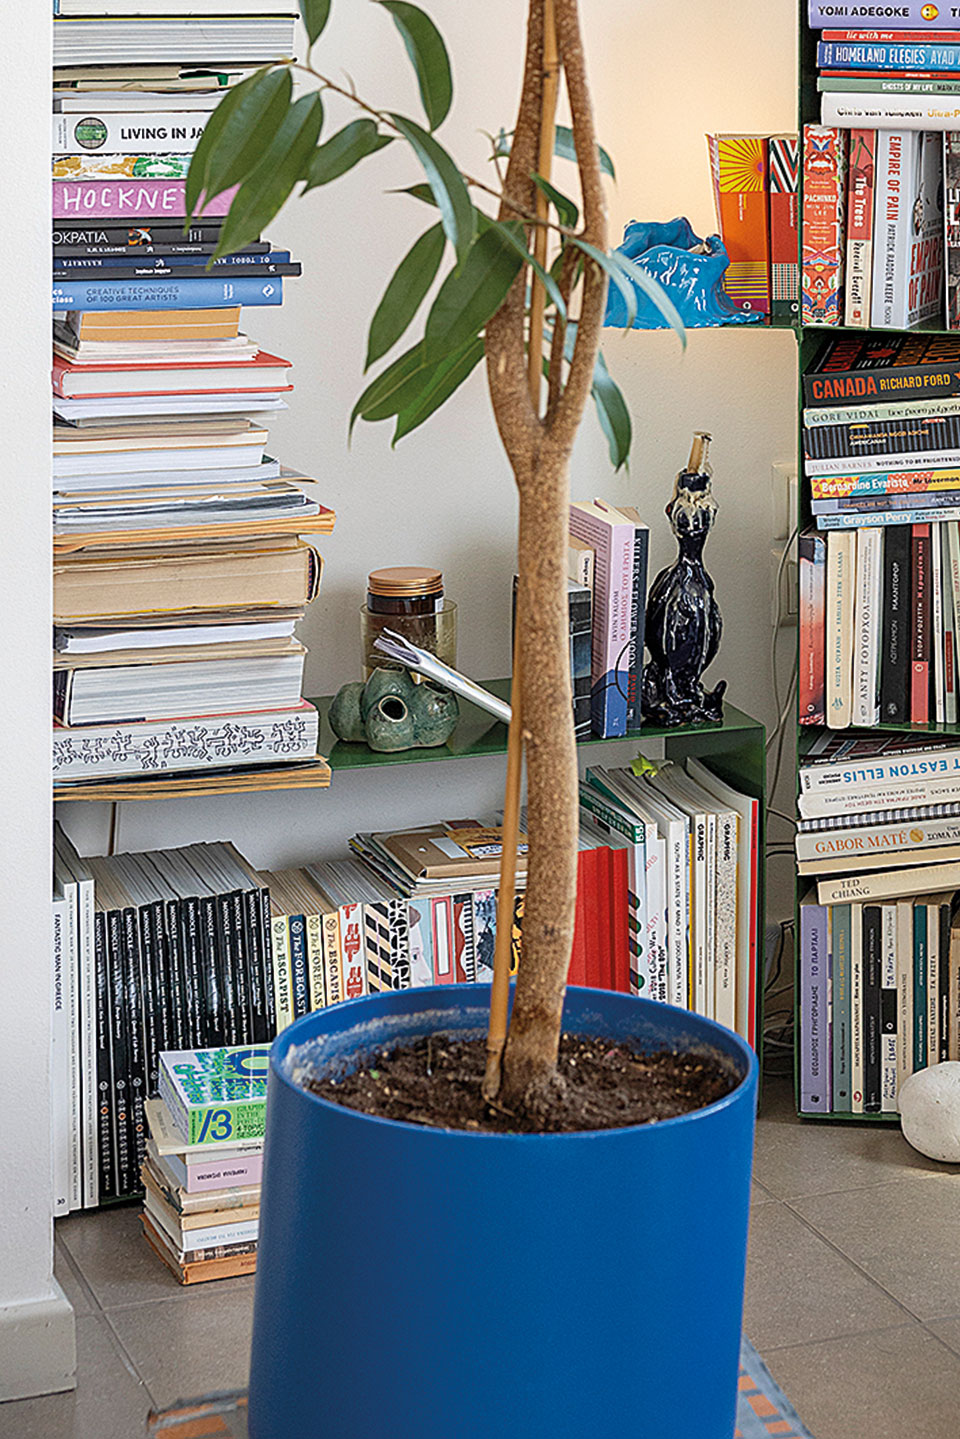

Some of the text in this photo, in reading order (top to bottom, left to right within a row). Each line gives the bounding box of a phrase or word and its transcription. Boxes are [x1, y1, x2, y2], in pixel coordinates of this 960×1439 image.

[818, 6, 848, 16] YOMI
[851, 7, 909, 17] ADEGOKE
[836, 47, 886, 62] HOMELAND
[889, 49, 925, 64] ELEGIES
[930, 49, 954, 65] AYAD
[121, 127, 168, 140] LIVING
[171, 128, 187, 139] IN
[856, 176, 866, 196] The
[63, 188, 186, 211] HOCKNE
[804, 194, 837, 202] PACHINKO
[855, 197, 866, 228] Trees
[884, 136, 902, 304] EMPIRE OF PAIN PATRICK RADDEN KEEFE
[143, 294, 178, 302] ARTISTS
[812, 373, 951, 400] CANADA RICHARD FORD
[812, 412, 841, 423] GORE
[845, 410, 879, 420] VIDAL
[822, 479, 871, 493] Bernardine
[843, 514, 884, 525] Grayson
[885, 512, 913, 525] Perry
[620, 632, 627, 641] Ο
[843, 768, 885, 783] ELLIS
[890, 759, 948, 777] EASTON
[696, 824, 705, 862] GRAPHIC
[723, 824, 731, 862] GRAPHIC
[815, 832, 907, 854] GABOR MATÉ
[832, 887, 870, 899] CHIANG
[840, 879, 860, 889] TED
[222, 901, 230, 935] MONOCLE
[54, 914, 62, 1011] FANTASTIC MAN IN GREECE
[277, 953, 287, 1012] ESCAPIST
[295, 952, 306, 1013] FORECAST
